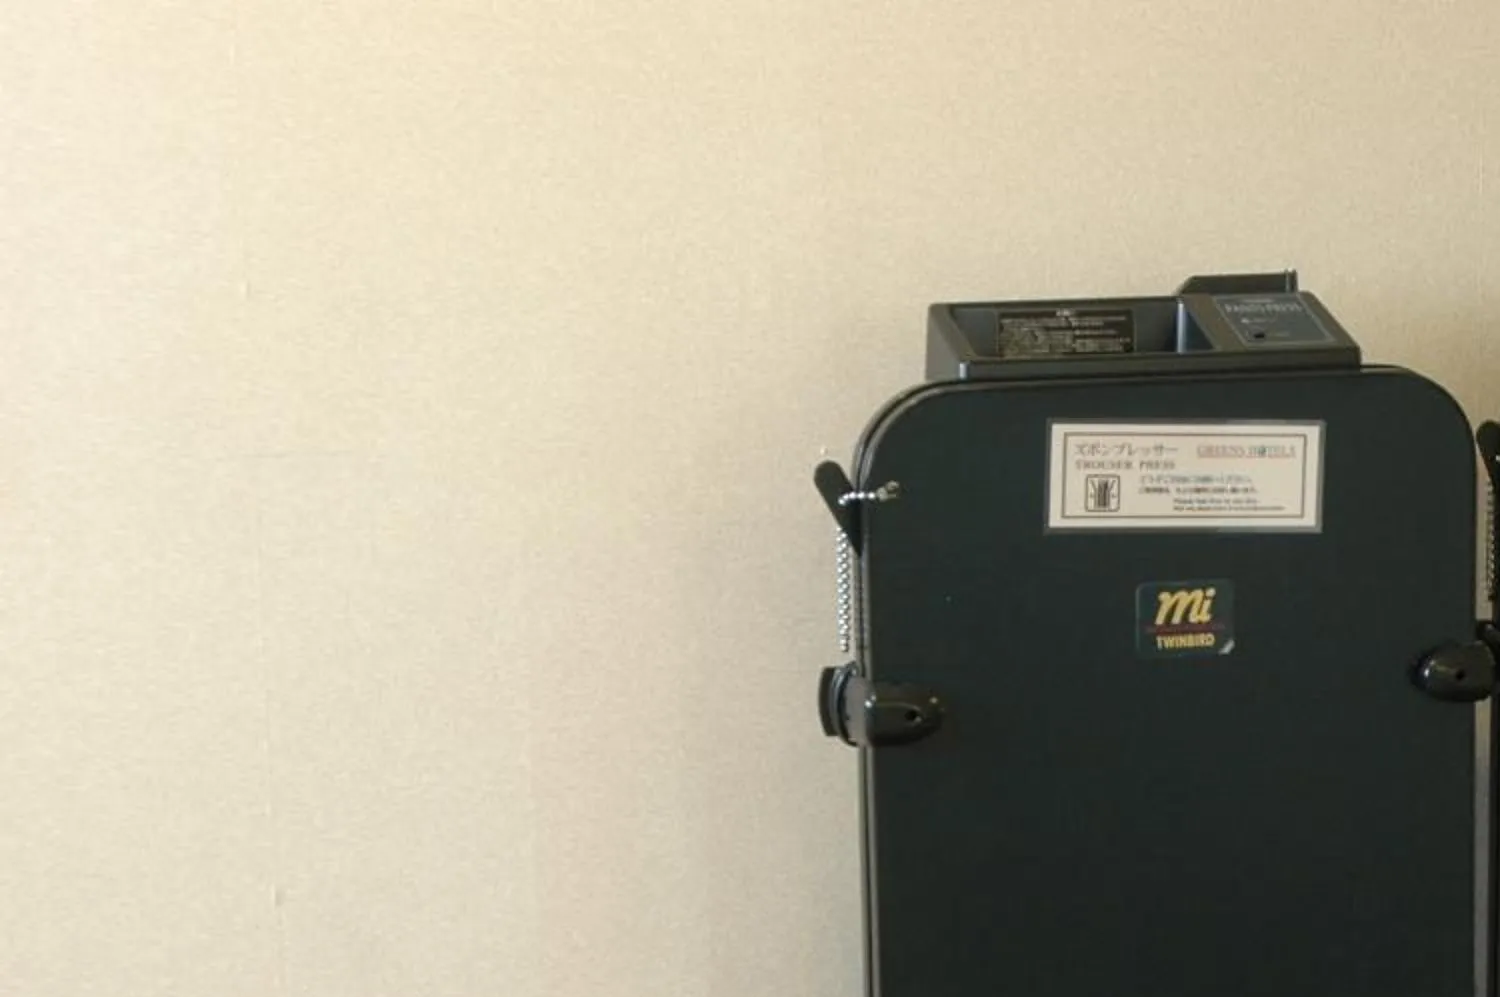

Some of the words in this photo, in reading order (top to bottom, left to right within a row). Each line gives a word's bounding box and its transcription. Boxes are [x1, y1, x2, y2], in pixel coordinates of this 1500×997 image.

[1074, 442, 1179, 456] ズボンプレッサー
[1075, 459, 1133, 470] TROUSER
[1139, 459, 1176, 470] PRESS
[1156, 633, 1215, 649] TWINBIRD
